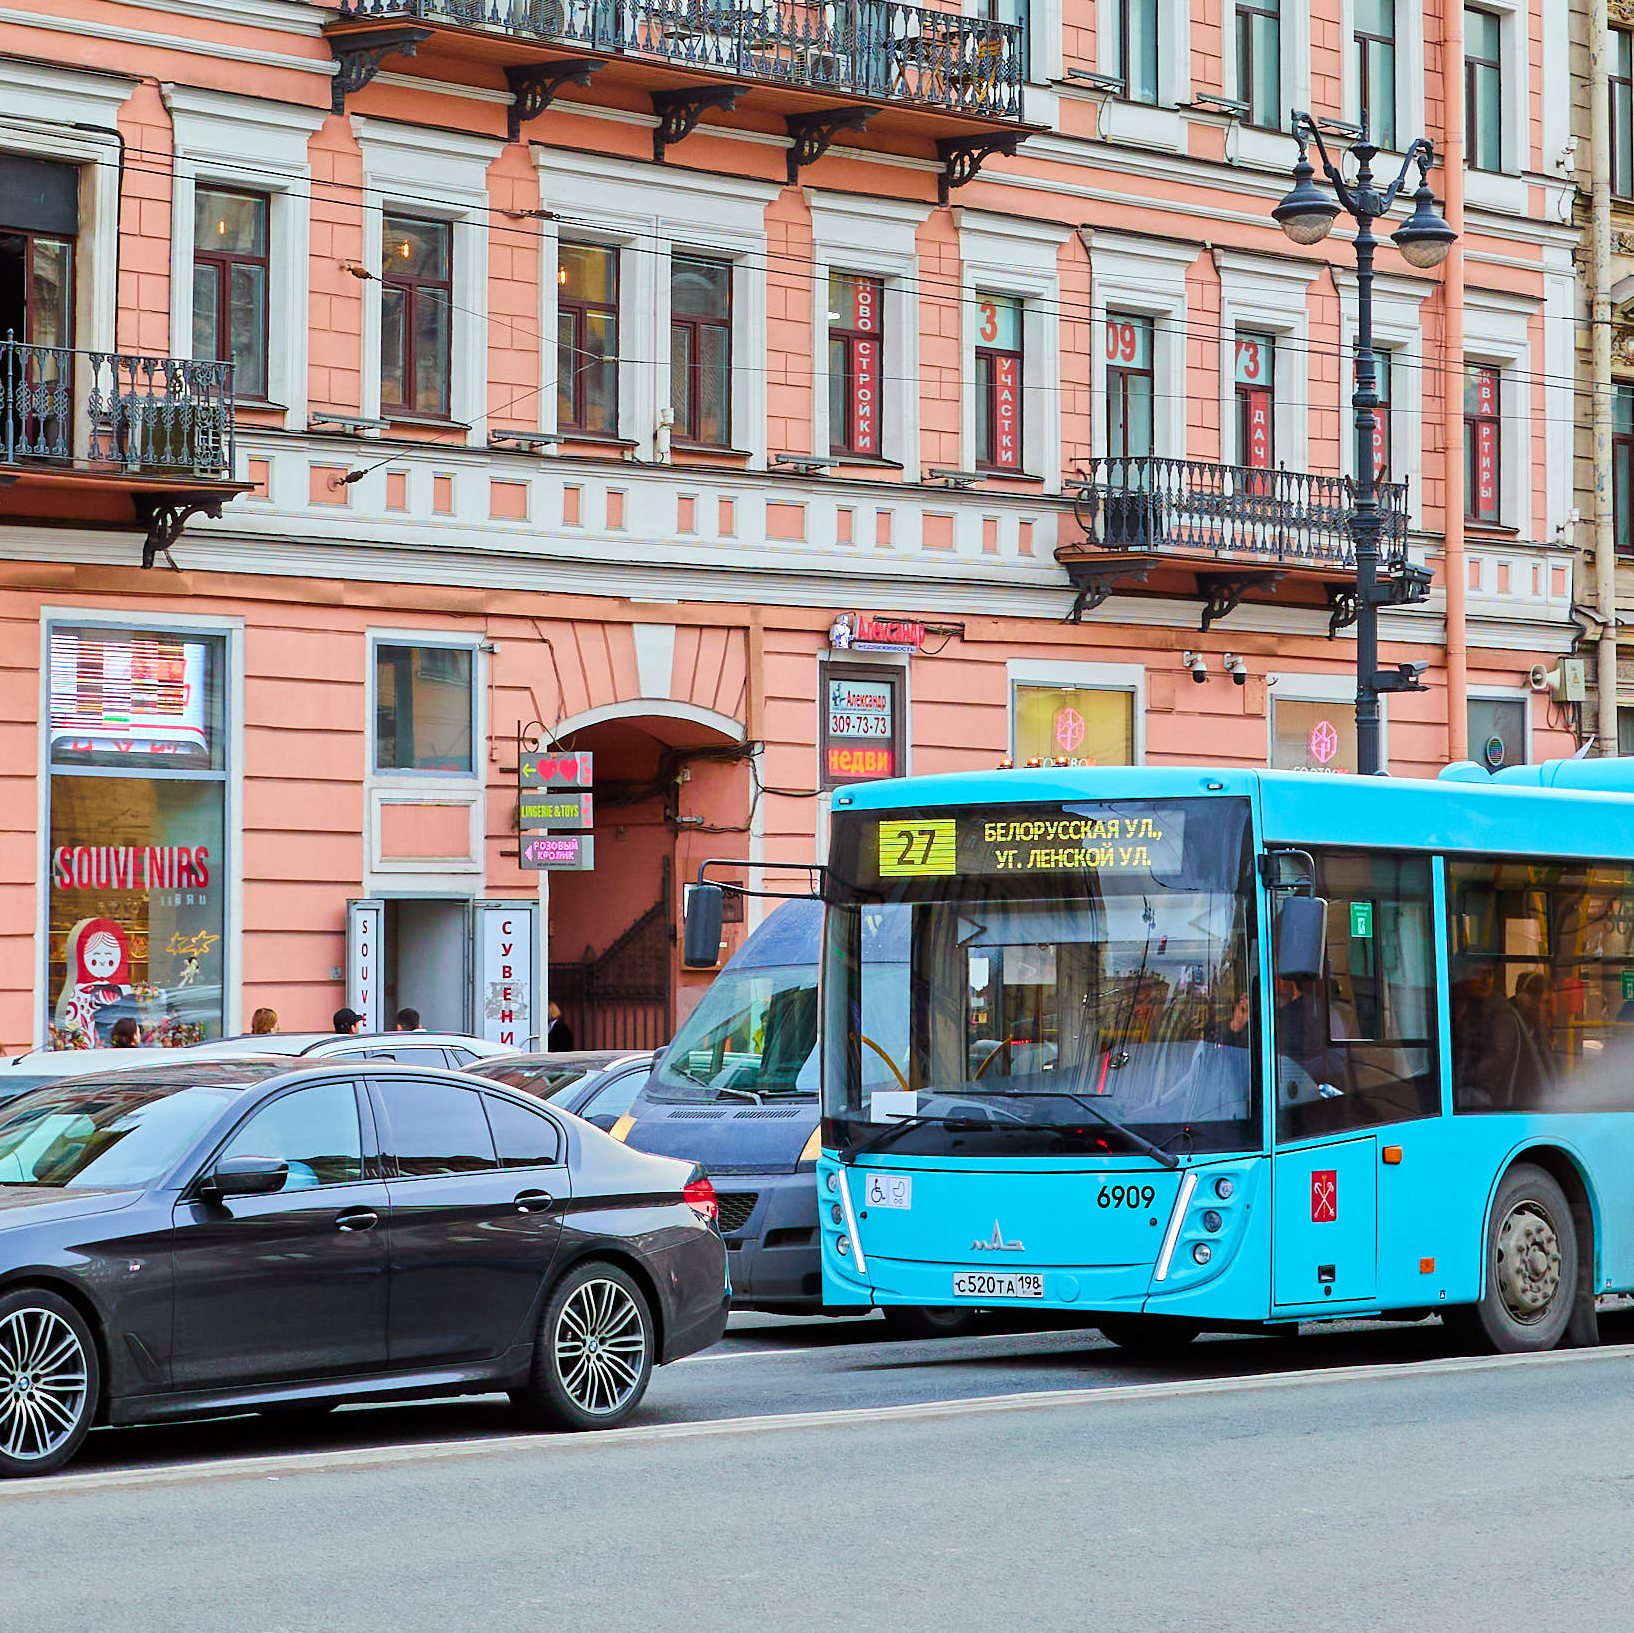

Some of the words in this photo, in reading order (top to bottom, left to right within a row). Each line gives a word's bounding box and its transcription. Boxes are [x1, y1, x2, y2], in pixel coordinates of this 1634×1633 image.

[1000, 358, 1013, 462] УЧАСТКИ
[1253, 409, 1265, 470] ДАЧ
[846, 690, 887, 712] Александр
[831, 715, 887, 735] 309-73-73
[828, 750, 889, 773] недви
[521, 805, 553, 818] LINGERIE
[984, 818, 1122, 843] БЕЛОРУССКАЯ
[533, 838, 579, 851] РОЗОВЫЙ
[896, 829, 936, 866] 27
[1027, 841, 1115, 868] ЛЕНСКОЙ
[55, 846, 210, 890] SOUVENIRS
[1097, 1185, 1155, 1209] 6909
[1017, 1276, 1041, 1290] 198
